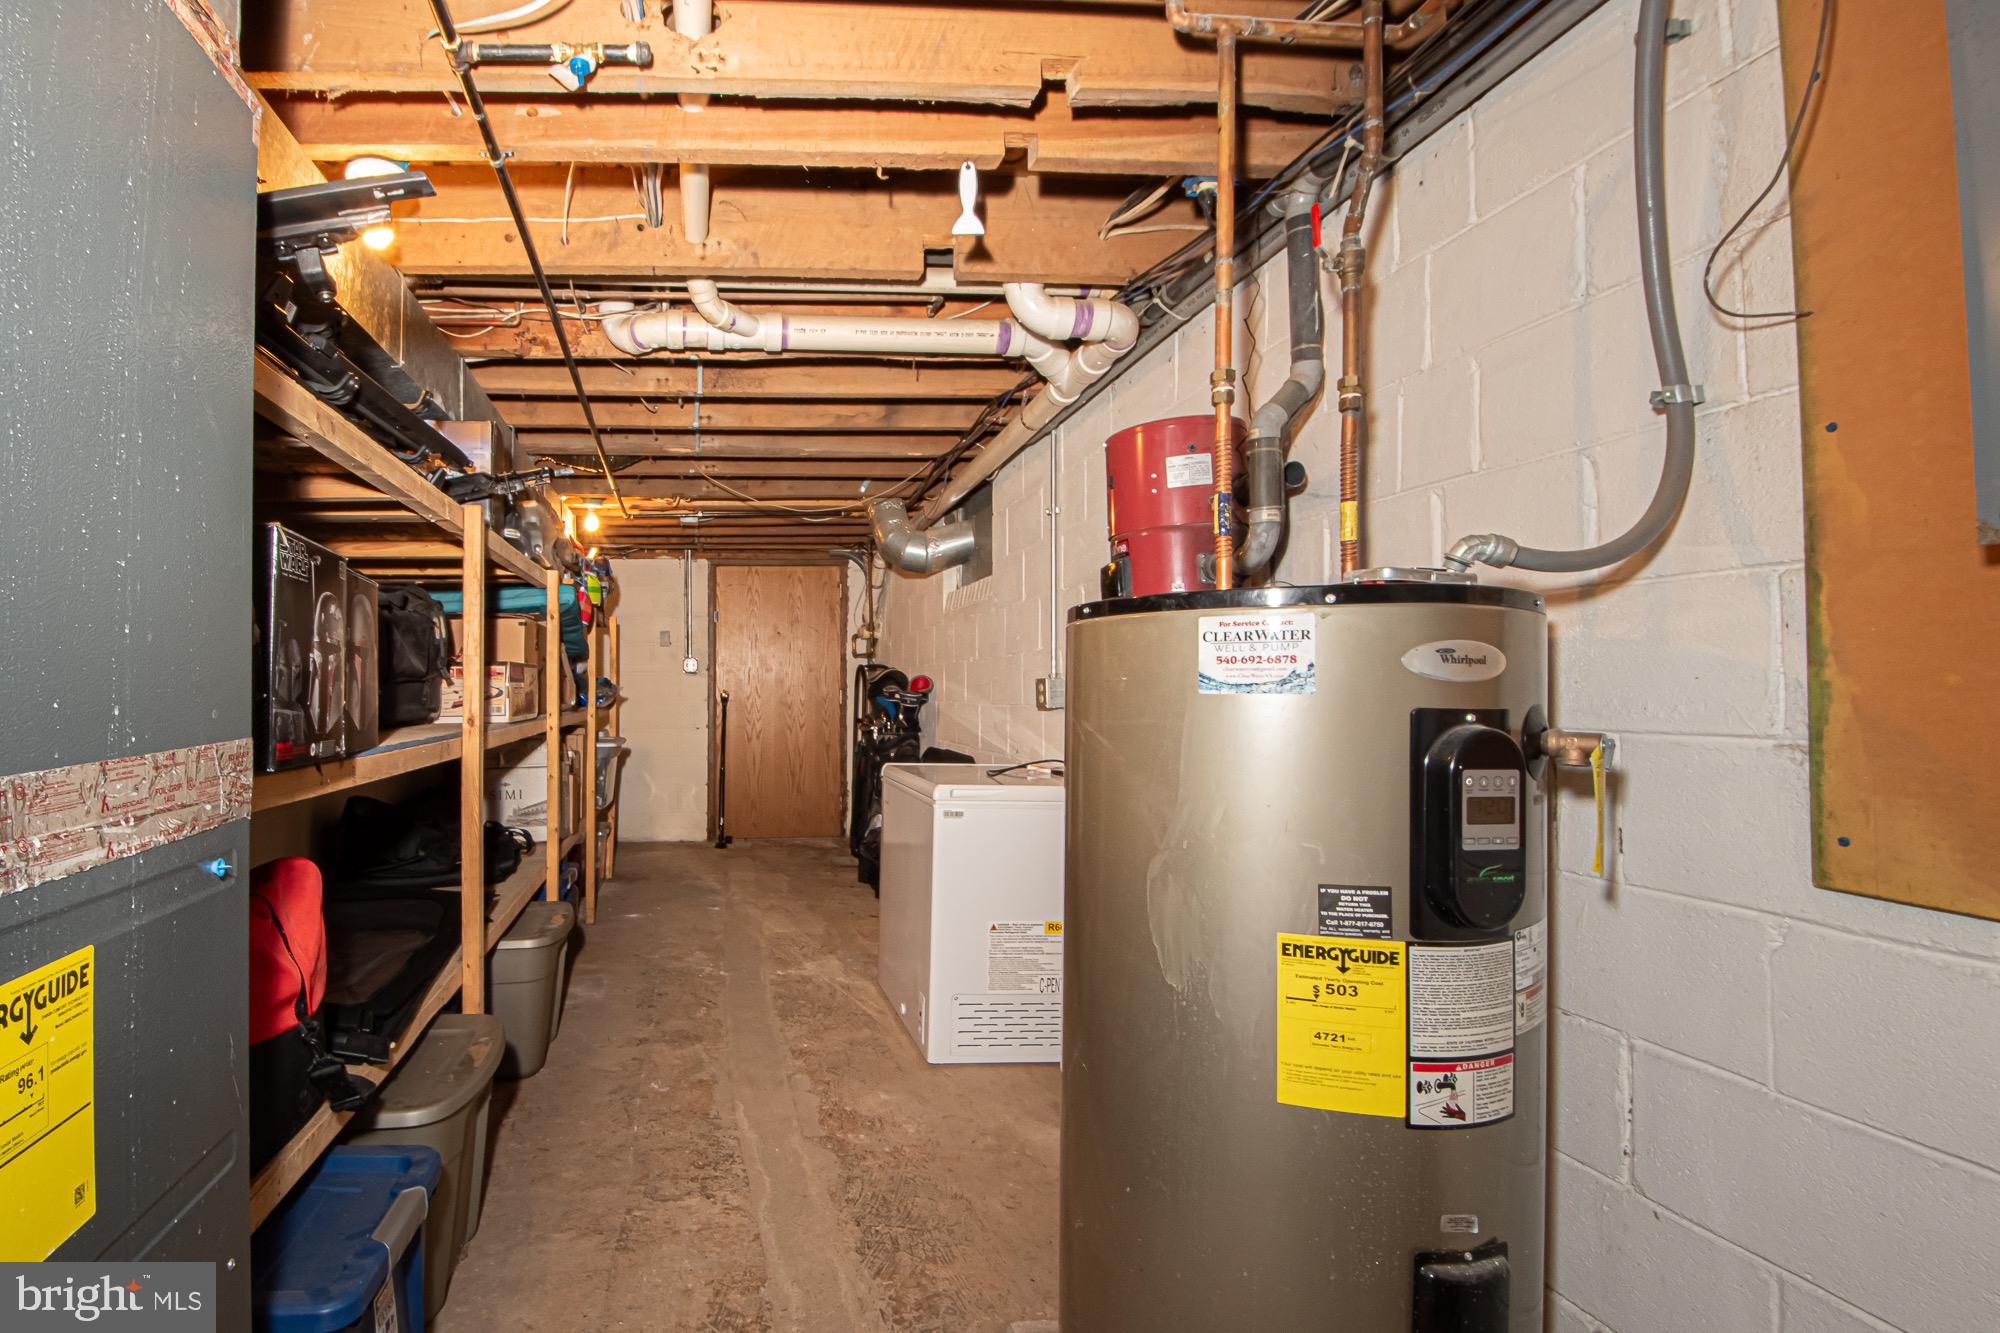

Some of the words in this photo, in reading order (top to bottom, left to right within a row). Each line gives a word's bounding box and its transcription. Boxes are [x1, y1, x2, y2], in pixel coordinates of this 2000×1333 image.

[280, 535, 308, 561] STAR
[280, 551, 309, 577] WARS
[1232, 619, 1260, 627] Service
[1214, 643, 1244, 652] WELL
[1248, 643, 1257, 652] &
[1262, 642, 1299, 652] PUMP
[1216, 655, 1297, 665] 540-692-6878
[1439, 654, 1486, 668] Whirlpool
[488, 789, 523, 800] SIMI
[111, 797, 149, 811] HARDCAST
[1281, 942, 1401, 970] ENERGYGUIDE
[1039, 977, 1063, 993] C-PEN
[1295, 973, 1323, 982] Estimated
[1342, 978, 1370, 987] Operating
[1312, 984, 1321, 994] $
[1325, 983, 1359, 997] 503
[1313, 1031, 1346, 1043] 4721
[1462, 1059, 1496, 1070] DANGER
[17, 1064, 44, 1095] 96.1
